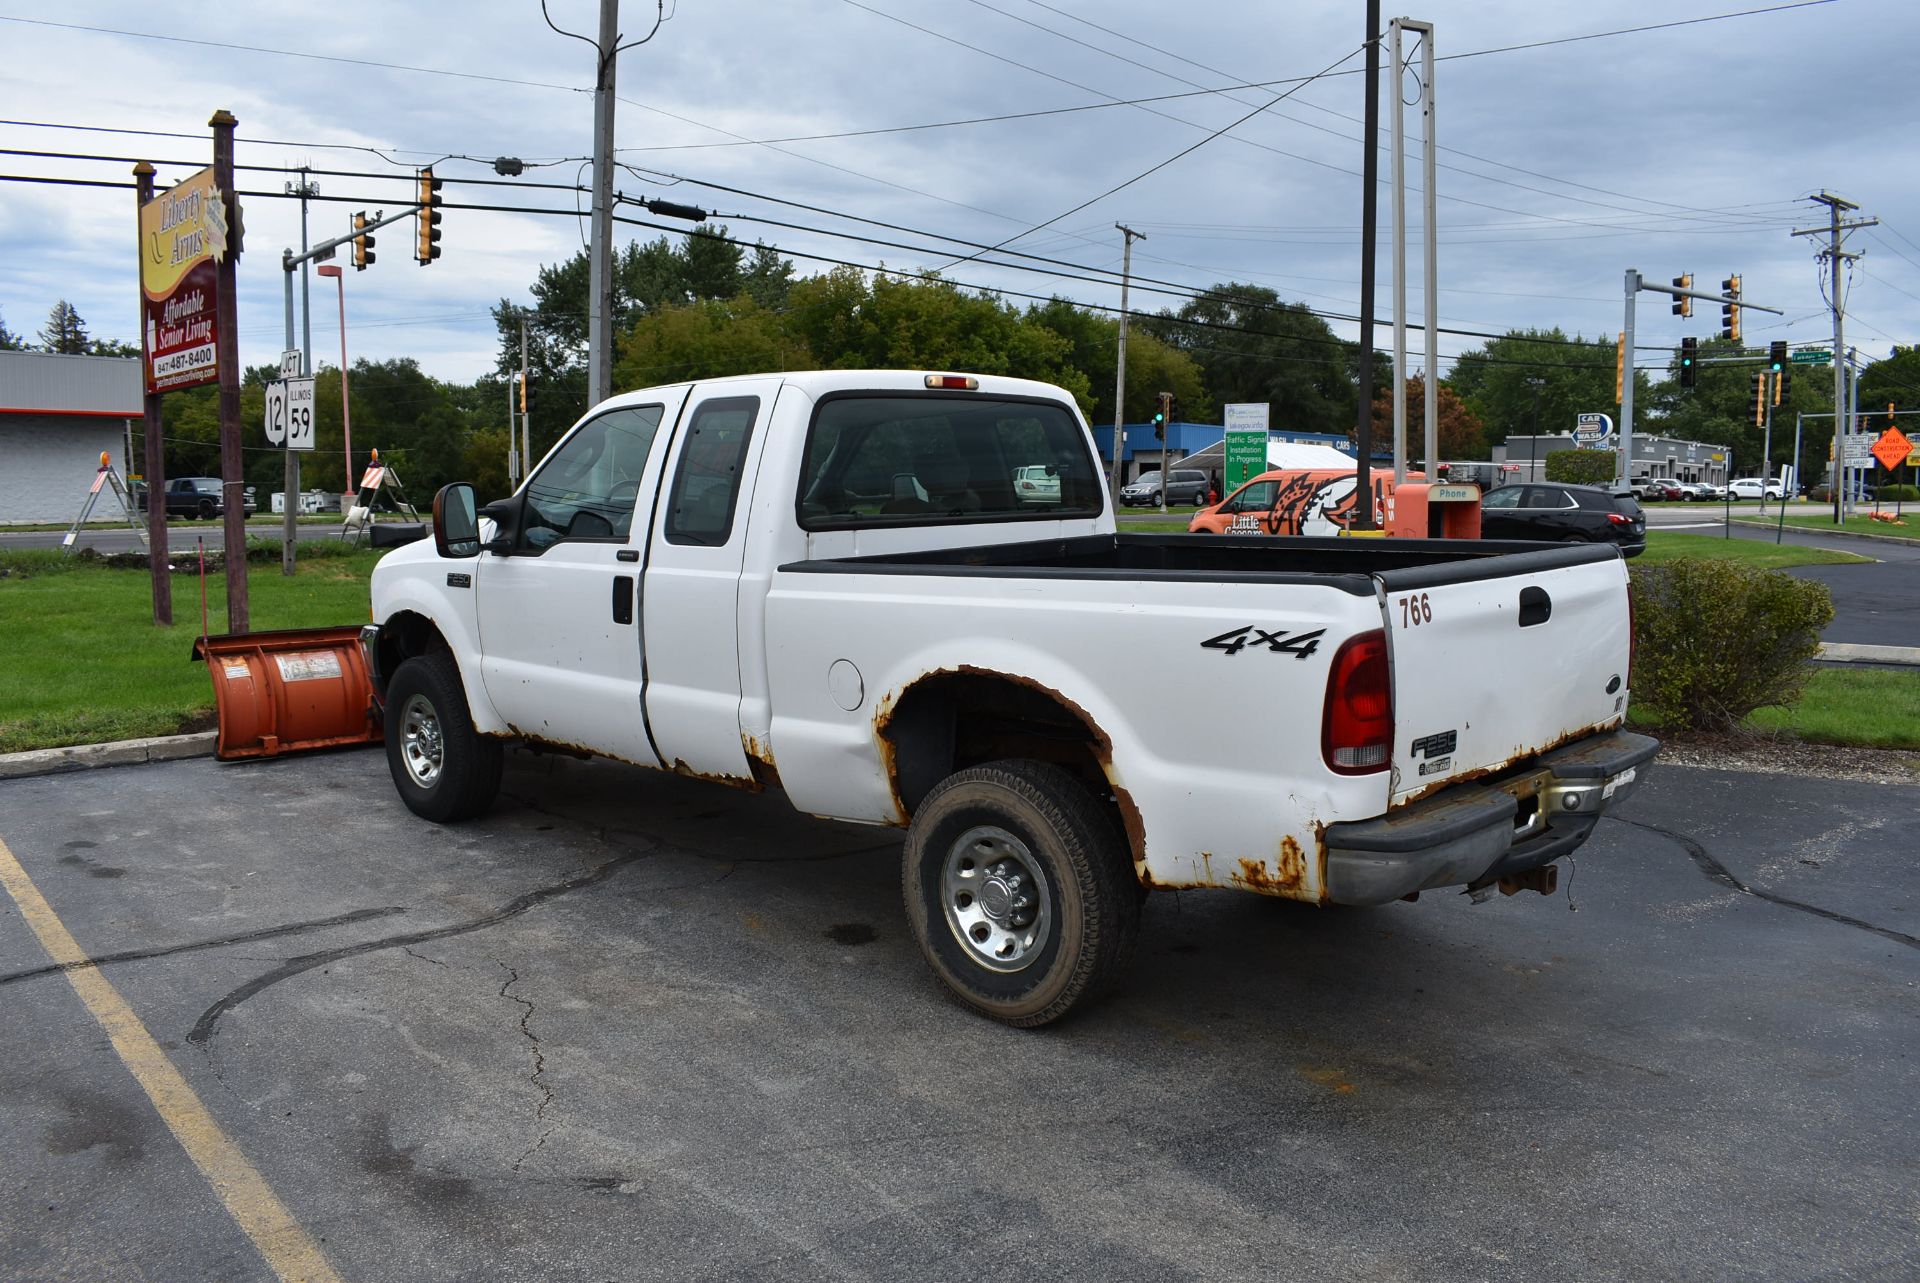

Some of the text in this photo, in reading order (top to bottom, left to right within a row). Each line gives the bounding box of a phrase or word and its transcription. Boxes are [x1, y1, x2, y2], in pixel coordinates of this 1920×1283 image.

[161, 188, 202, 234] Liberty
[169, 229, 203, 265] Arms
[163, 289, 204, 328] Affordable
[160, 316, 211, 350] Senior Living
[282, 355, 297, 374] JCT
[290, 389, 312, 401] ILLINOIS
[269, 395, 282, 431] 12
[291, 407, 310, 439] 59
[1226, 436, 1267, 445] Traffic Signal
[1577, 432, 1602, 440] WASH
[1439, 489, 1466, 498] Phone
[1232, 514, 1260, 530] Little
[1400, 592, 1432, 629] 766
